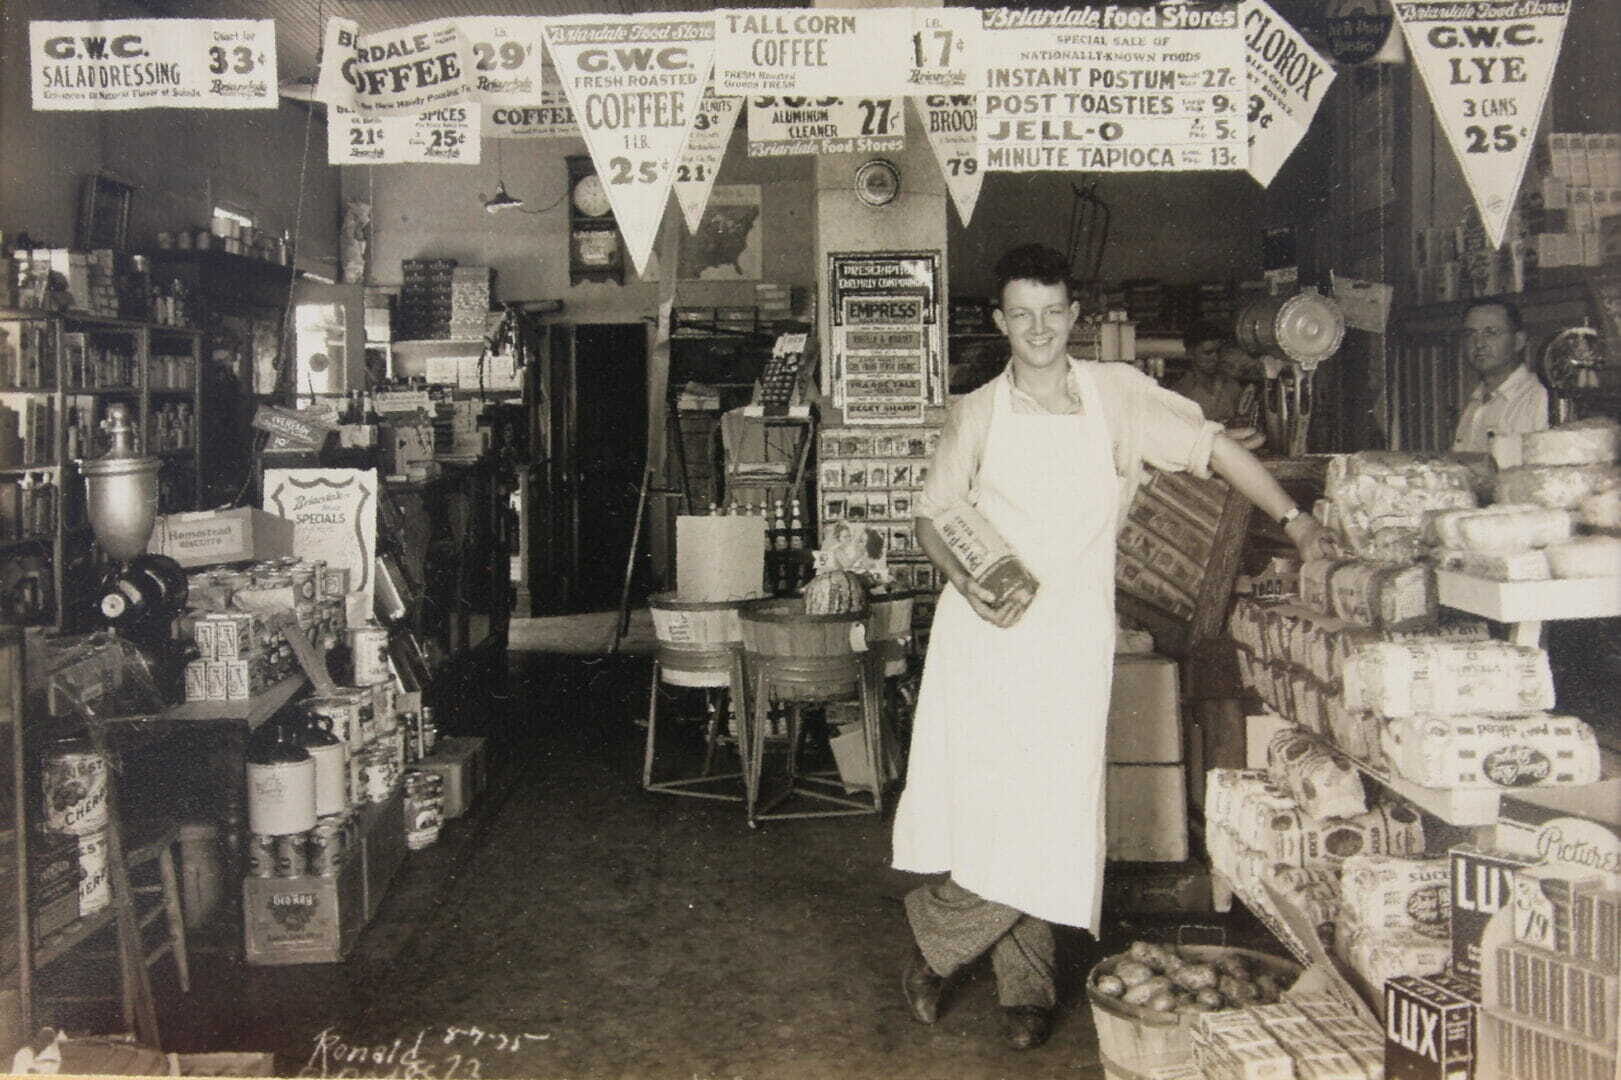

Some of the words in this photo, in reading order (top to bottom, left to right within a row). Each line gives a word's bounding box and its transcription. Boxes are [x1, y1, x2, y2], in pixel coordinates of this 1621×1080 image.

[725, 15, 789, 34] TALL
[794, 16, 856, 34] CORN
[983, 6, 1099, 28] Briardale
[1104, 6, 1156, 28] Food
[1162, 5, 1237, 28] Stores
[631, 25, 669, 41] Food
[1057, 35, 1107, 45] SPECIAL
[1113, 36, 1145, 46] SALE
[1153, 36, 1170, 46] OF
[1427, 25, 1543, 48] G.W.C.
[44, 35, 149, 60] G.W.C.
[752, 38, 828, 67] COFFEE
[1162, 52, 1201, 62] FOODS
[1245, 8, 1322, 101] CLOROX
[577, 47, 695, 72] G.W.C.
[574, 76, 623, 88] FRESH
[628, 74, 697, 87] ROASTED
[987, 68, 1082, 89] INSTANT
[1089, 68, 1175, 90] POSTUM
[1448, 57, 1527, 85] LYE
[585, 92, 686, 129] COFFEE
[698, 100, 732, 113] ALNUTS
[986, 95, 1060, 115] POST
[1067, 95, 1174, 116] TOASTIES
[1463, 99, 1478, 118] 3
[1481, 97, 1517, 118] CANS
[772, 109, 829, 125] ALUMINUM
[928, 109, 978, 133] BROO
[789, 124, 838, 138] CLEANER
[987, 120, 1124, 141] JELL-O
[822, 139, 854, 153] Food
[856, 138, 904, 152] Stores
[987, 148, 1070, 167] MINUTE
[1077, 148, 1175, 168] TAPIOCA
[850, 303, 916, 319] EMPRESS
[296, 512, 346, 524] SPECIALS
[1388, 990, 1439, 1063] LUX
[303, 1025, 424, 1078] Ronald
